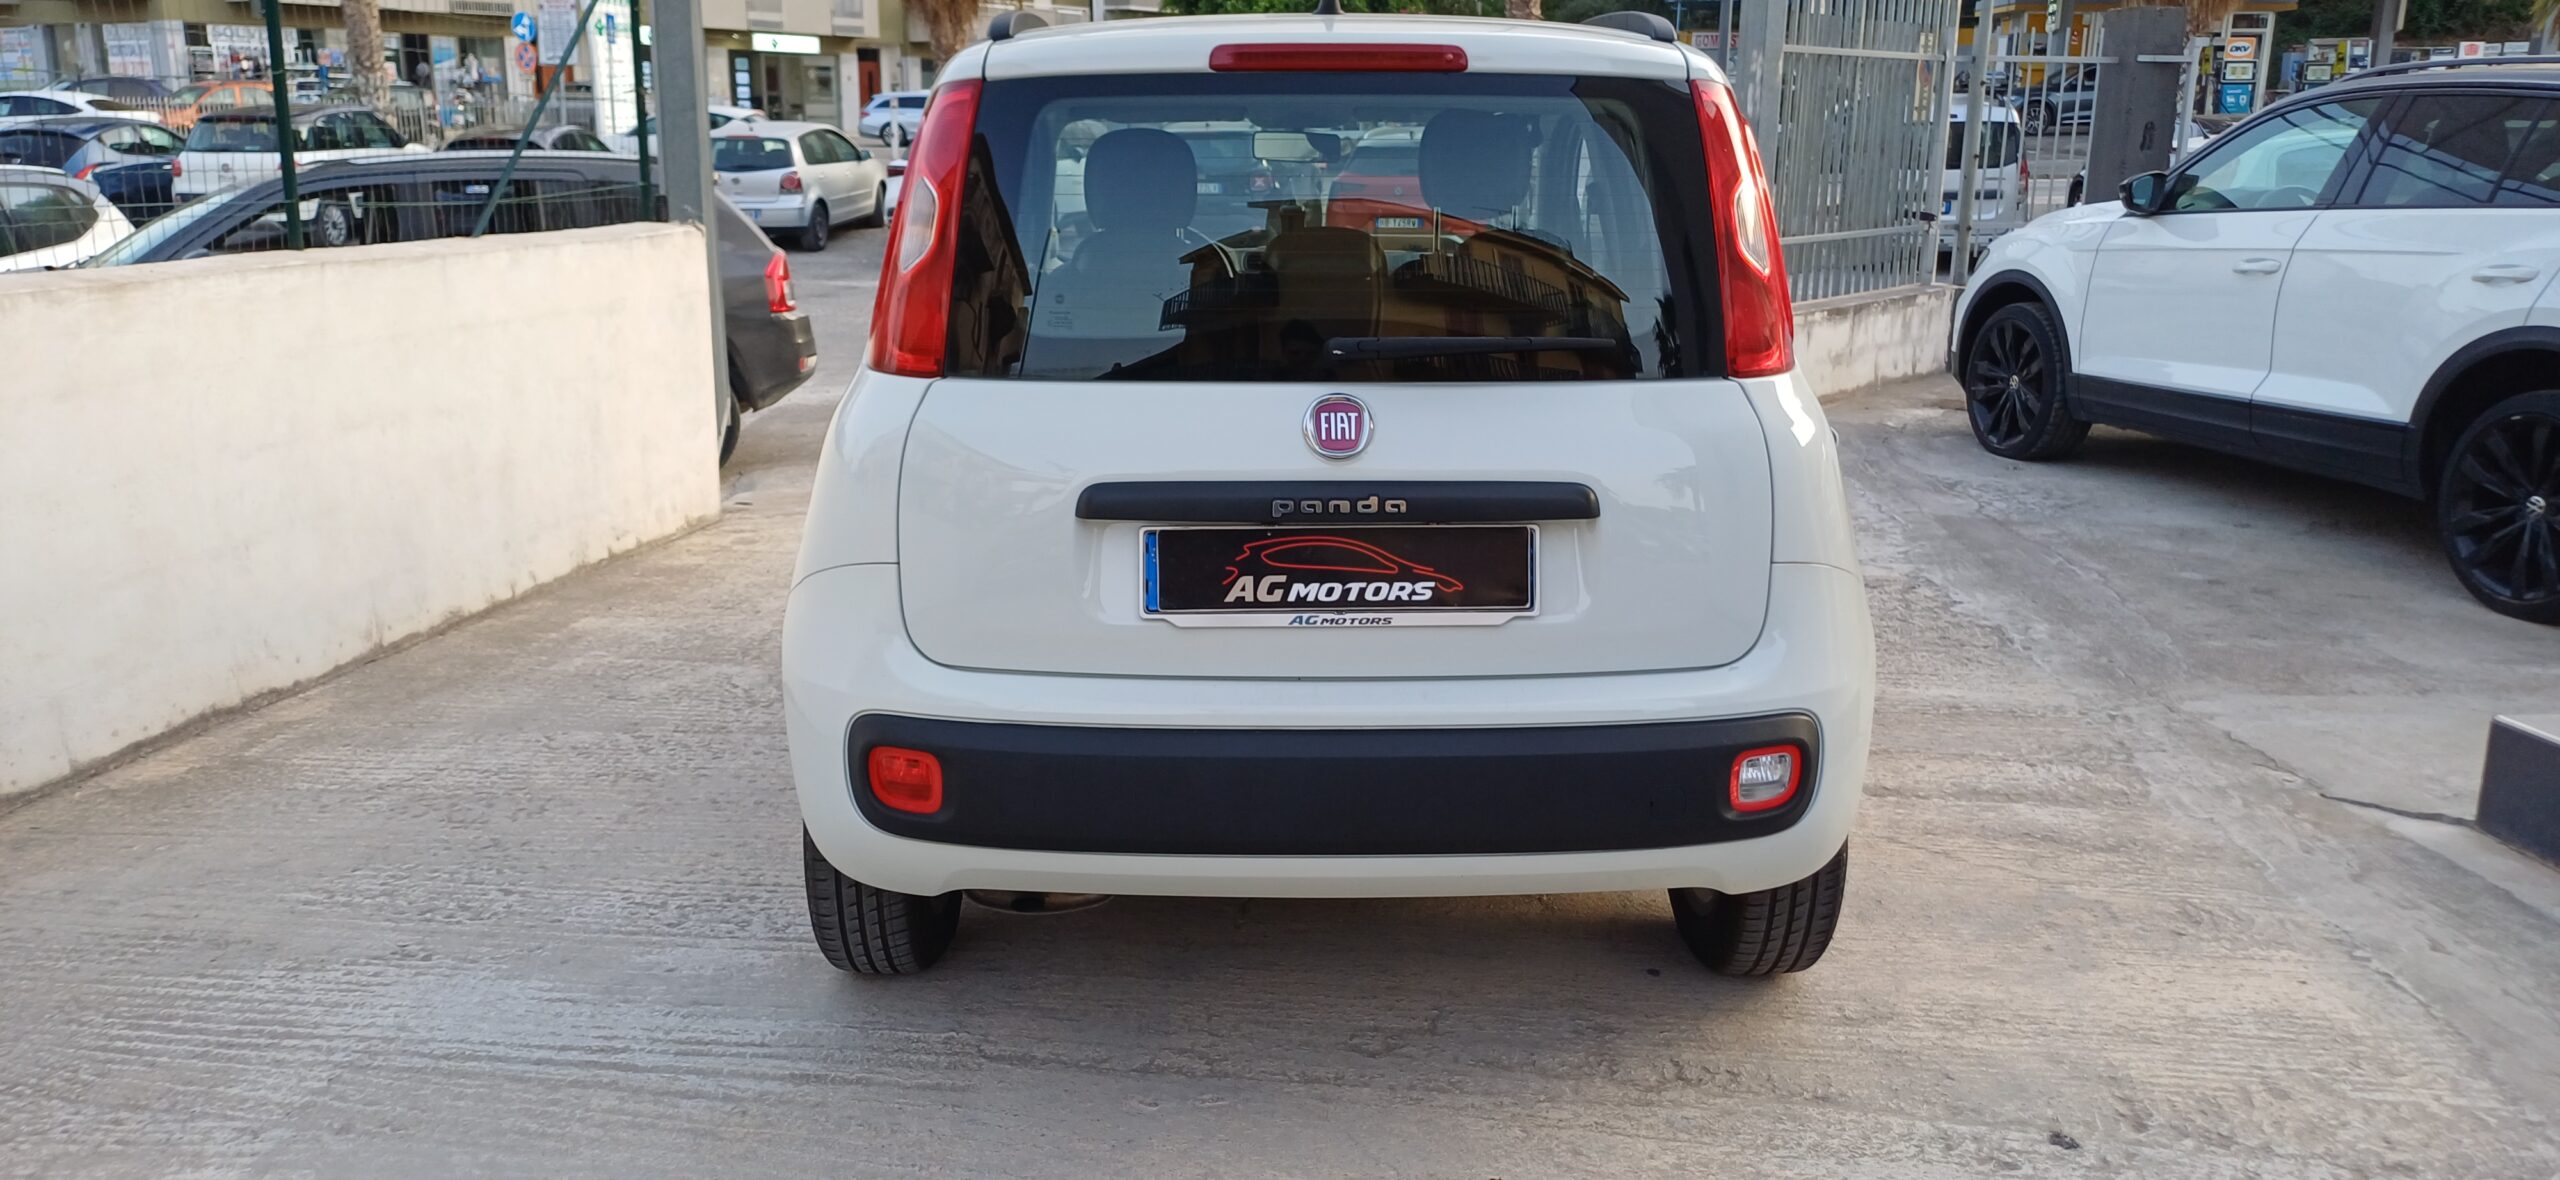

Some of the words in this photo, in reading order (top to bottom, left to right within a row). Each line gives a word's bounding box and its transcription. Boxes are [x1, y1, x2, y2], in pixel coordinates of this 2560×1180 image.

[2229, 45, 2251, 53] DKV
[1320, 411, 1359, 441] FIAT
[1272, 495, 1407, 518] panda
[1223, 575, 1288, 603] AG
[1286, 581, 1436, 602] MOTORS
[1287, 614, 1320, 626] AG
[1320, 616, 1394, 626] MOTORS
